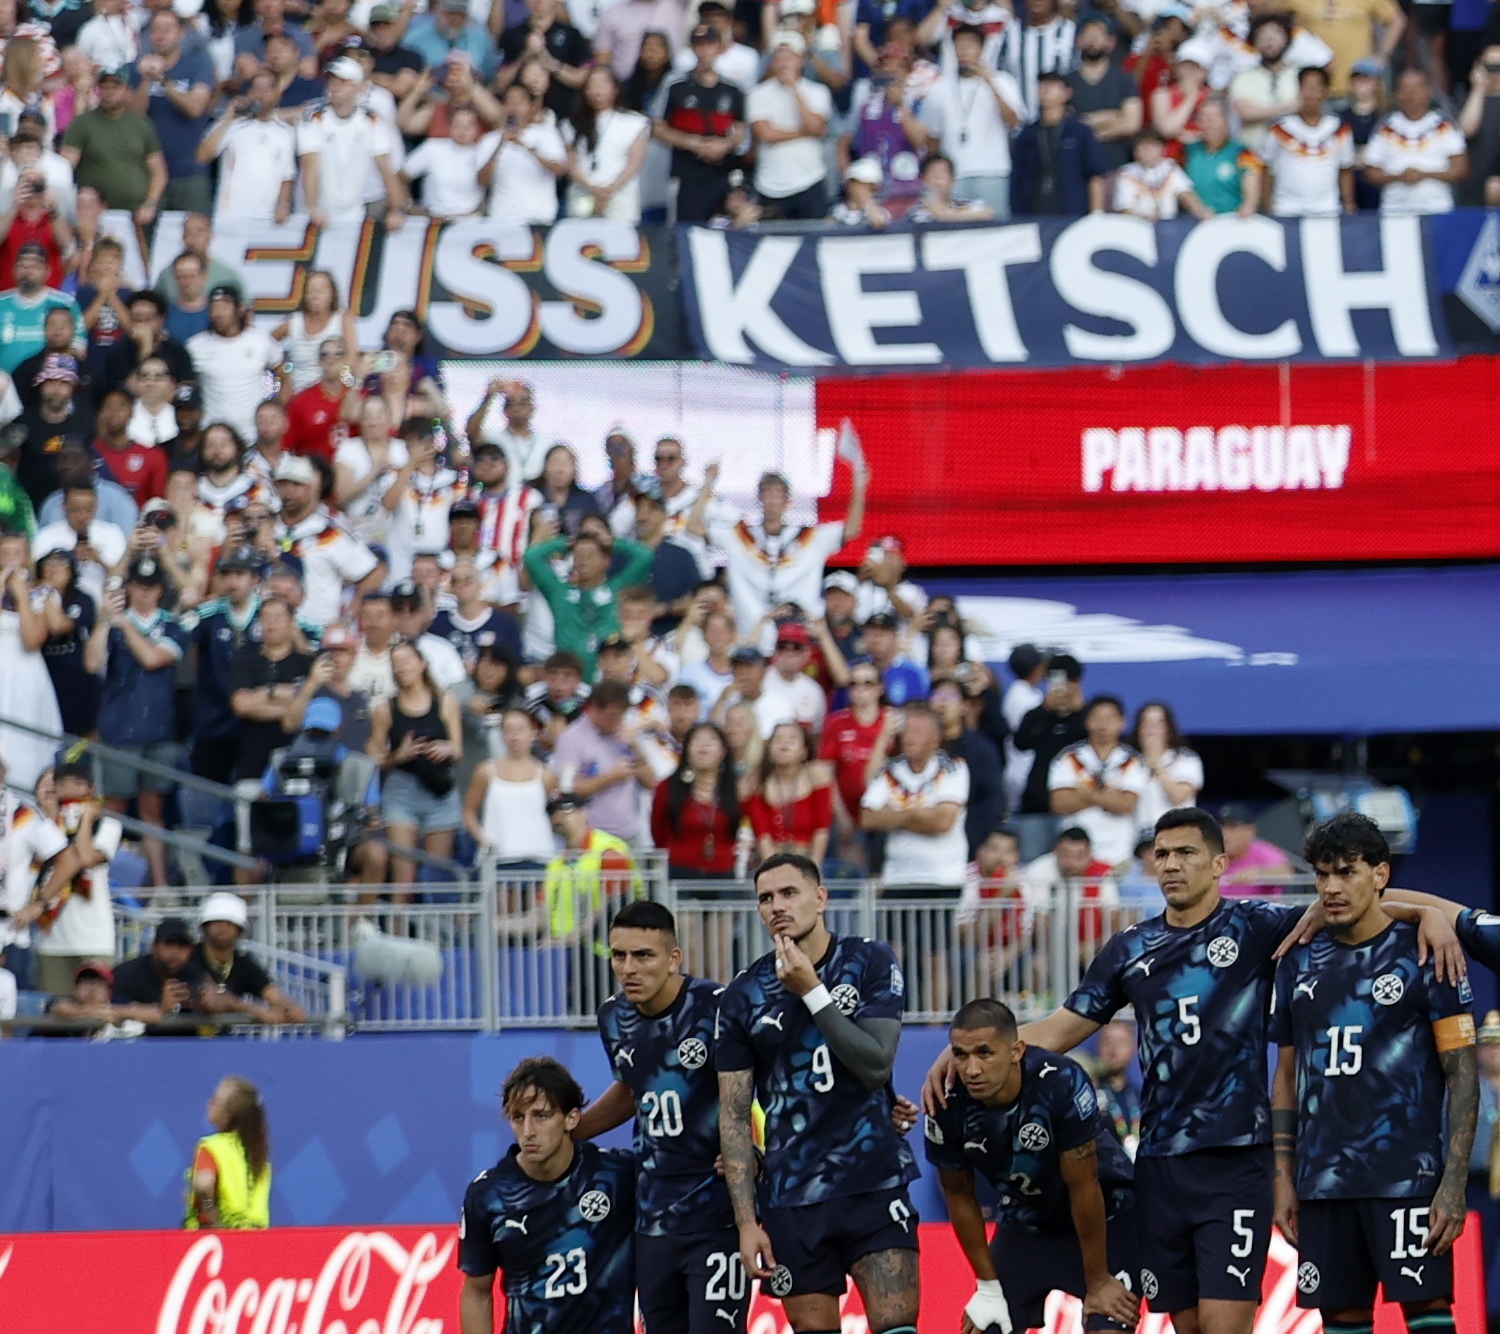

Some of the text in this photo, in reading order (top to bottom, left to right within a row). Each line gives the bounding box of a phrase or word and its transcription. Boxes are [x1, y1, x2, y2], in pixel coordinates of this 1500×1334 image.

[688, 213, 1440, 366] KETSCH
[1081, 424, 1352, 493] PARAGUAY
[1178, 994, 1202, 1047] 5
[811, 1046, 834, 1094] 9
[1324, 1025, 1363, 1077] 15
[641, 1089, 684, 1138] 20
[1231, 1209, 1256, 1259] 5
[1389, 1206, 1430, 1260] 15
[545, 1247, 588, 1300] 23
[704, 1251, 746, 1302] 20
